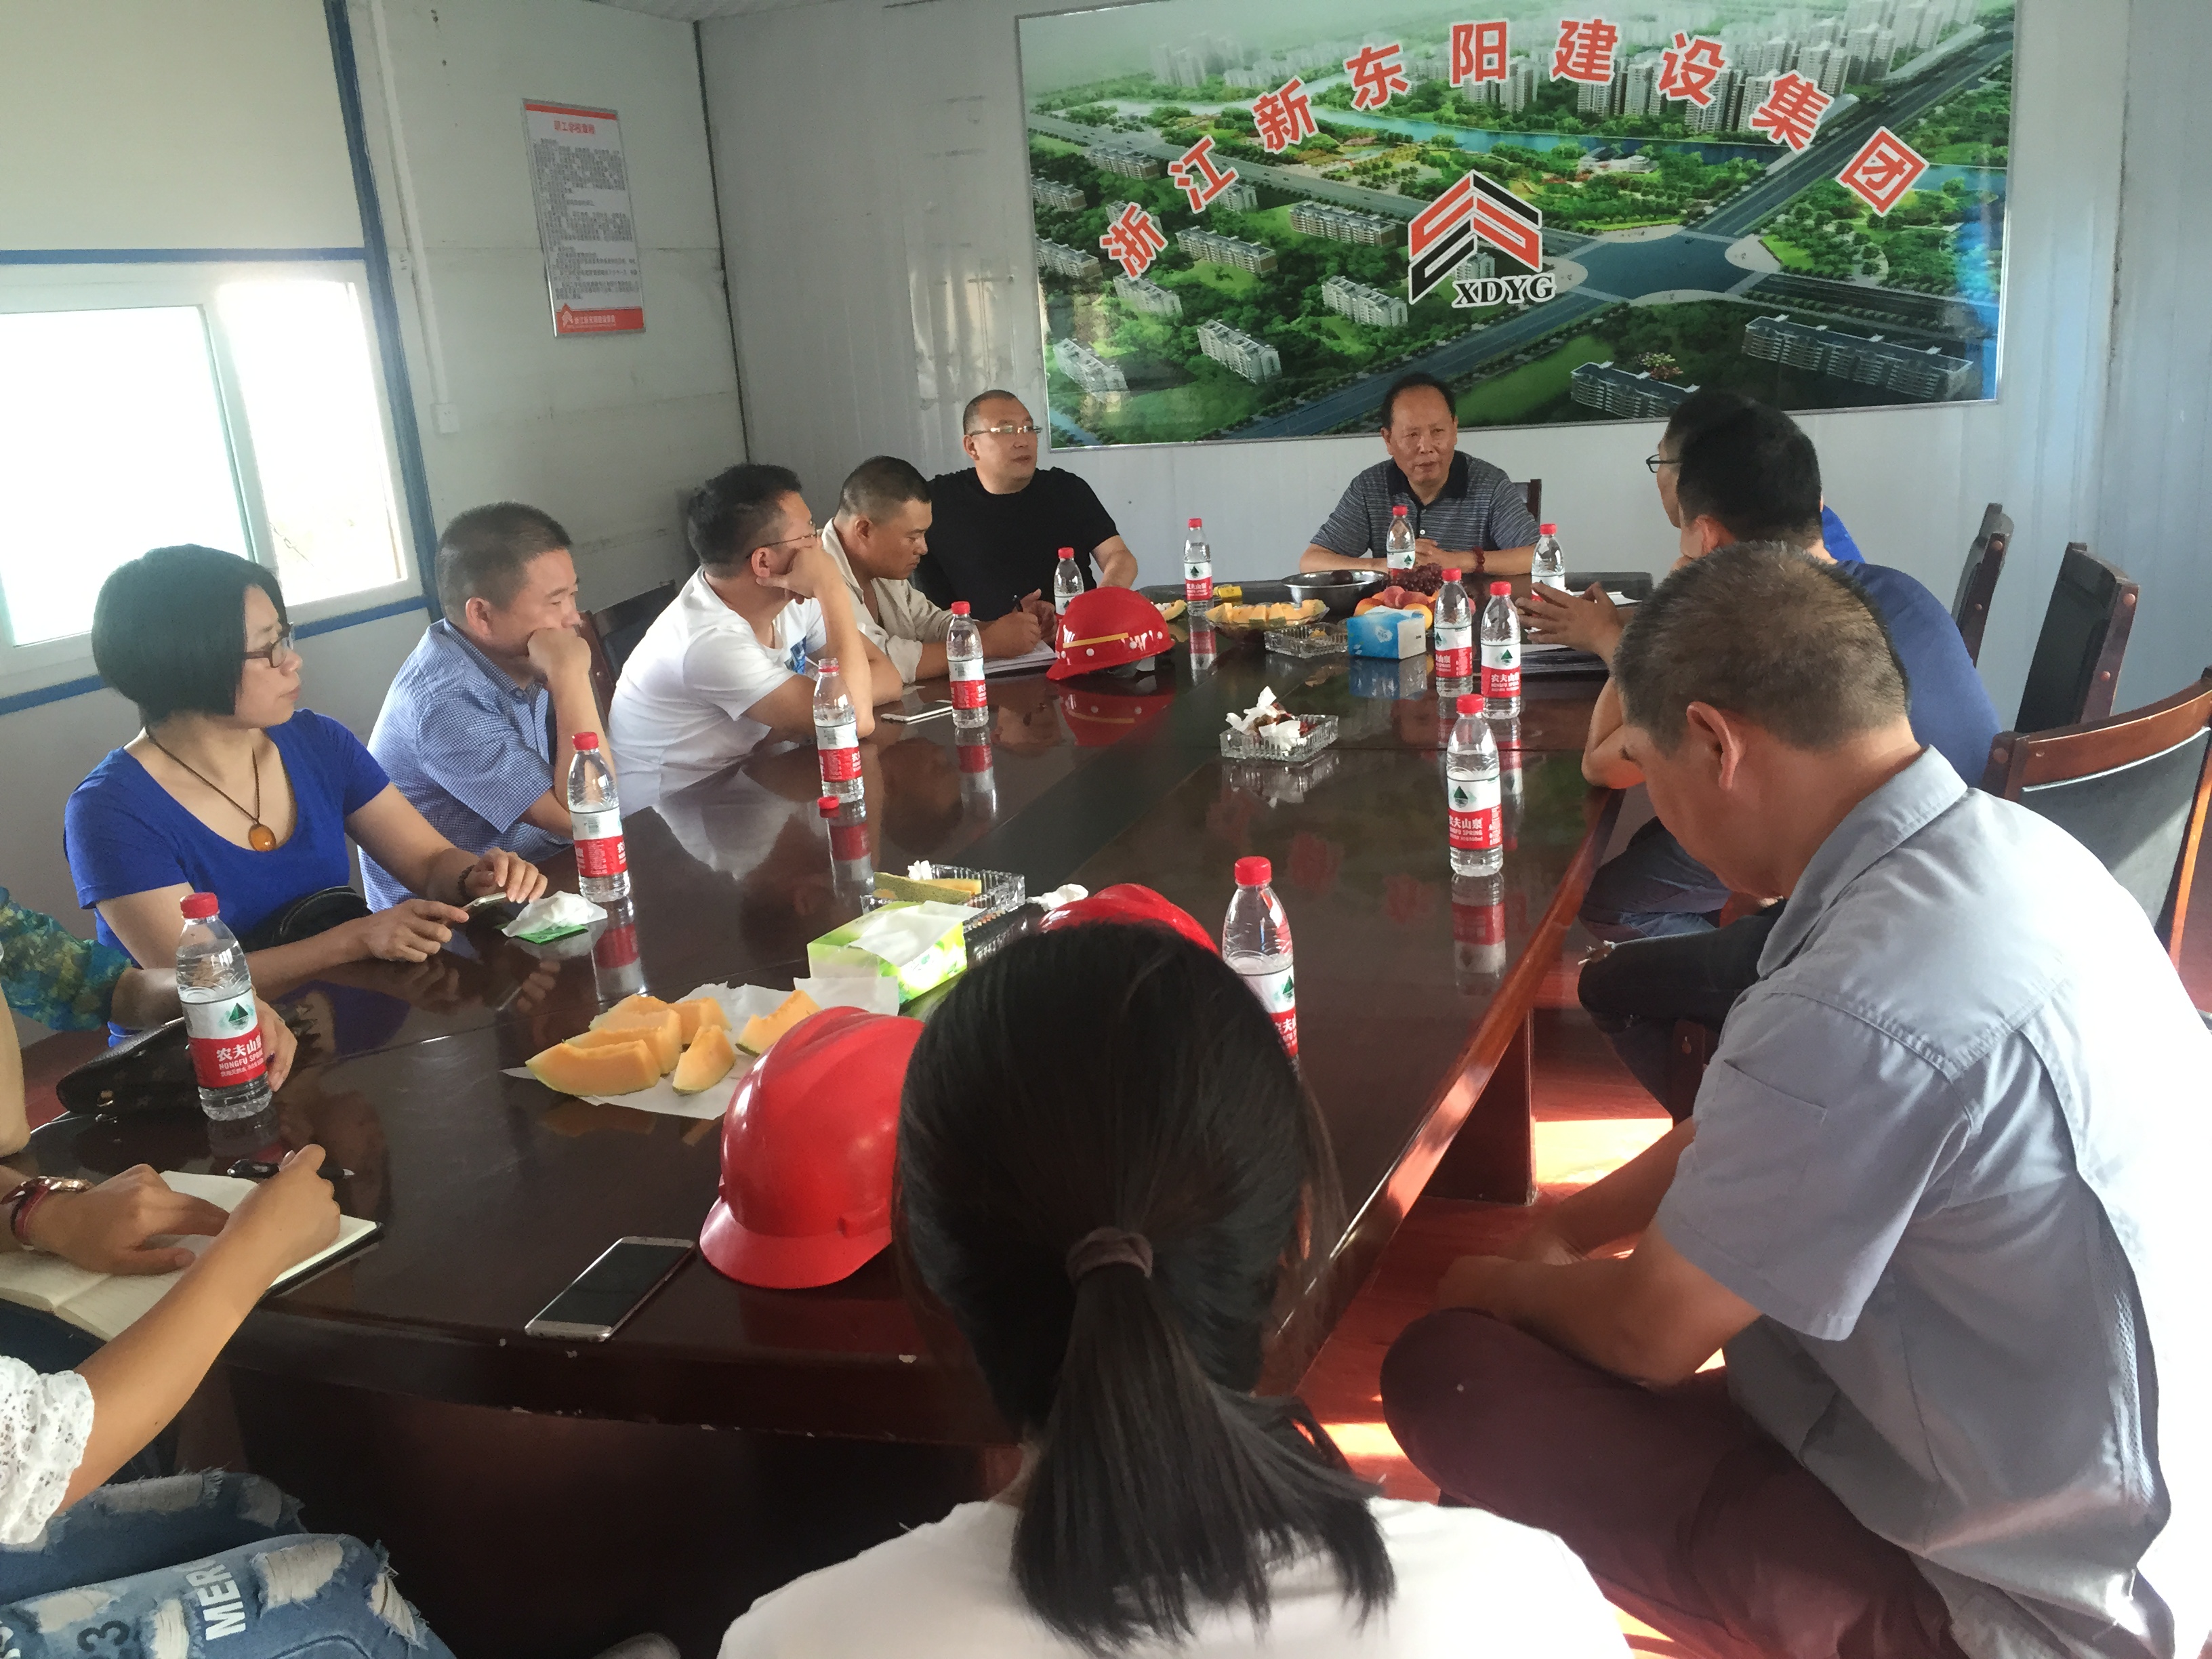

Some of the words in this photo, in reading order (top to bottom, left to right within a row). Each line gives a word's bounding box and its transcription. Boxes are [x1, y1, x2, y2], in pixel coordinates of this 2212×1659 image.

[1101, 18, 1929, 279] 浙江新东阳建设集团
[1452, 274, 1556, 307] XDYG
[218, 1057, 248, 1070] NONGFU
[186, 1559, 246, 1641] MER
